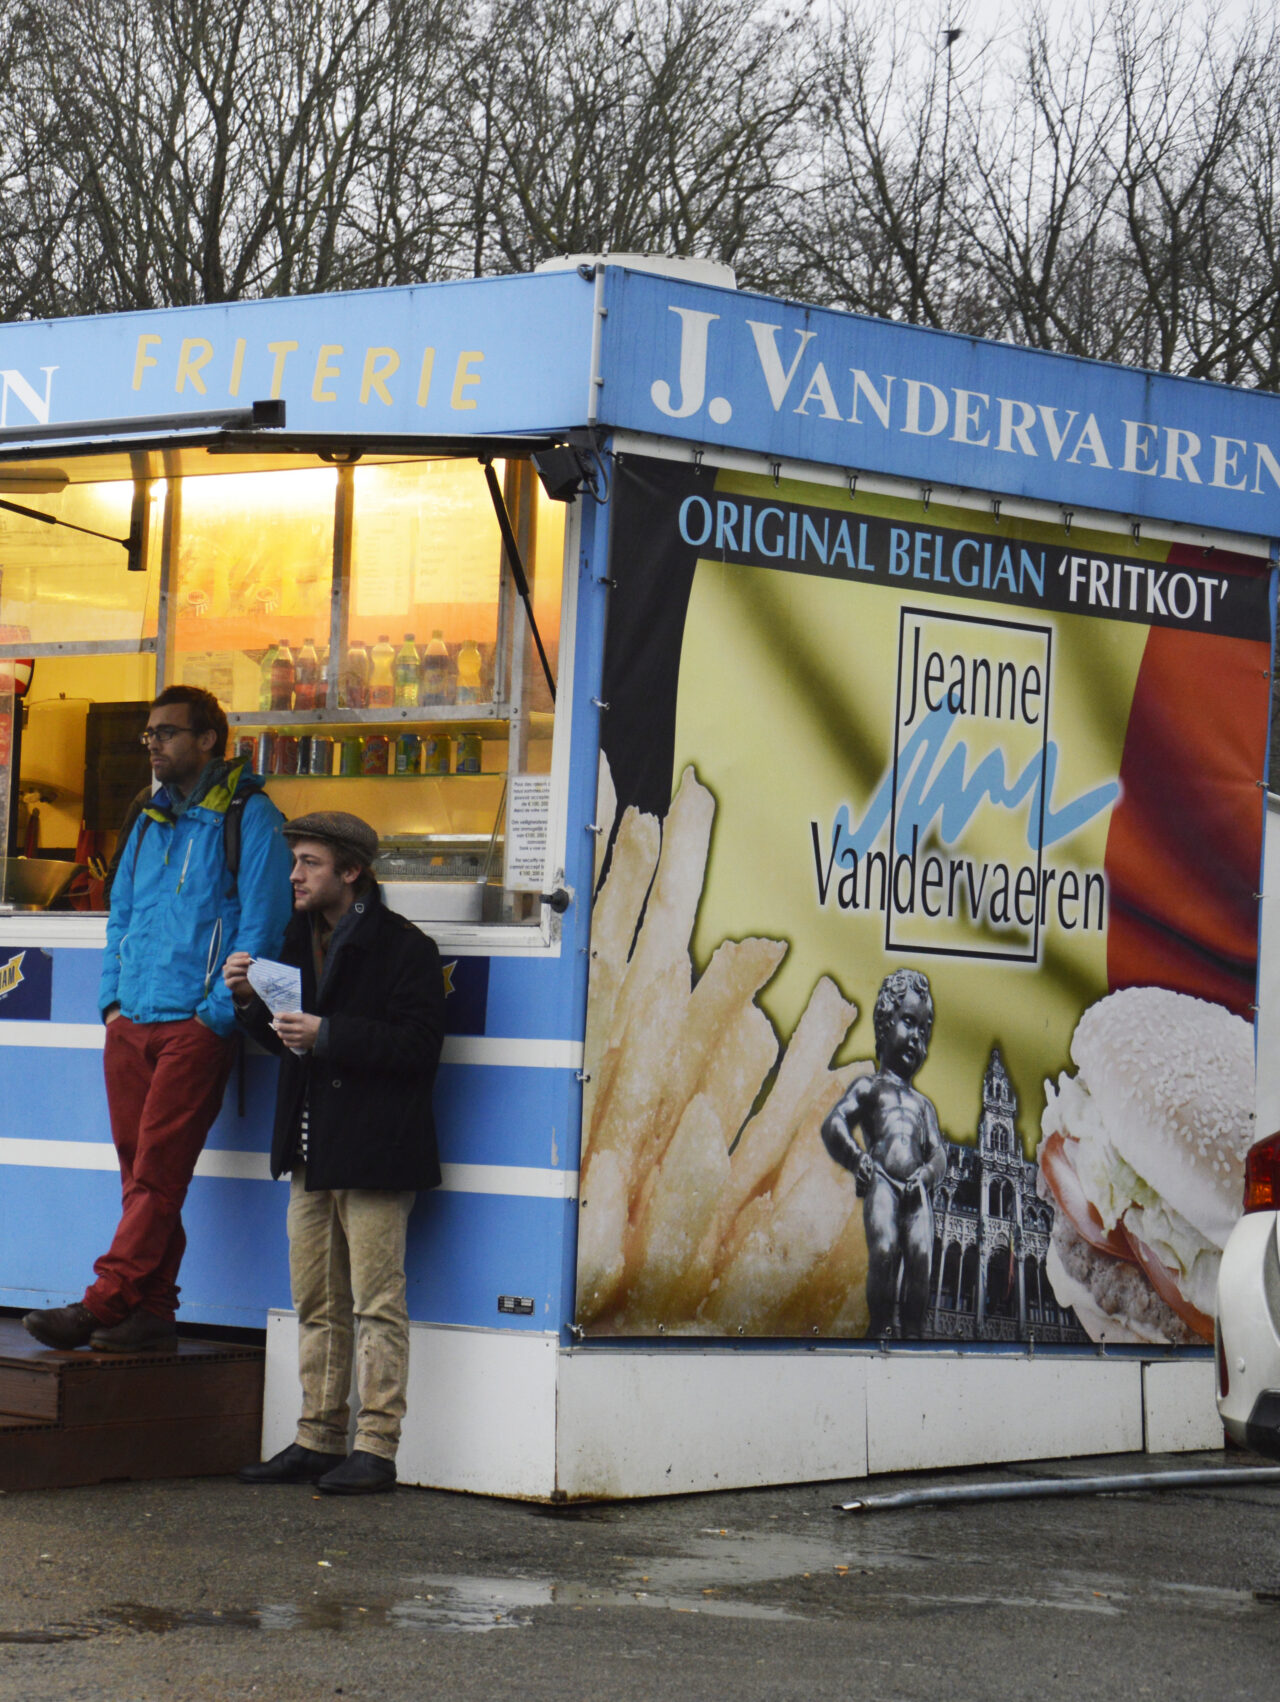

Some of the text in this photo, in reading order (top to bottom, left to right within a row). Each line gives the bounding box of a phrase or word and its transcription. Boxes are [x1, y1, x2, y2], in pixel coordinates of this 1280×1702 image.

[131, 333, 486, 411] FRITERIE
[650, 305, 1280, 495] J. VANDERVAEREN
[678, 495, 875, 573] ORIGINAL
[888, 528, 1047, 597] BELGIAN
[903, 626, 1043, 727] Jeanne
[810, 821, 1106, 932] Vandervaeren
